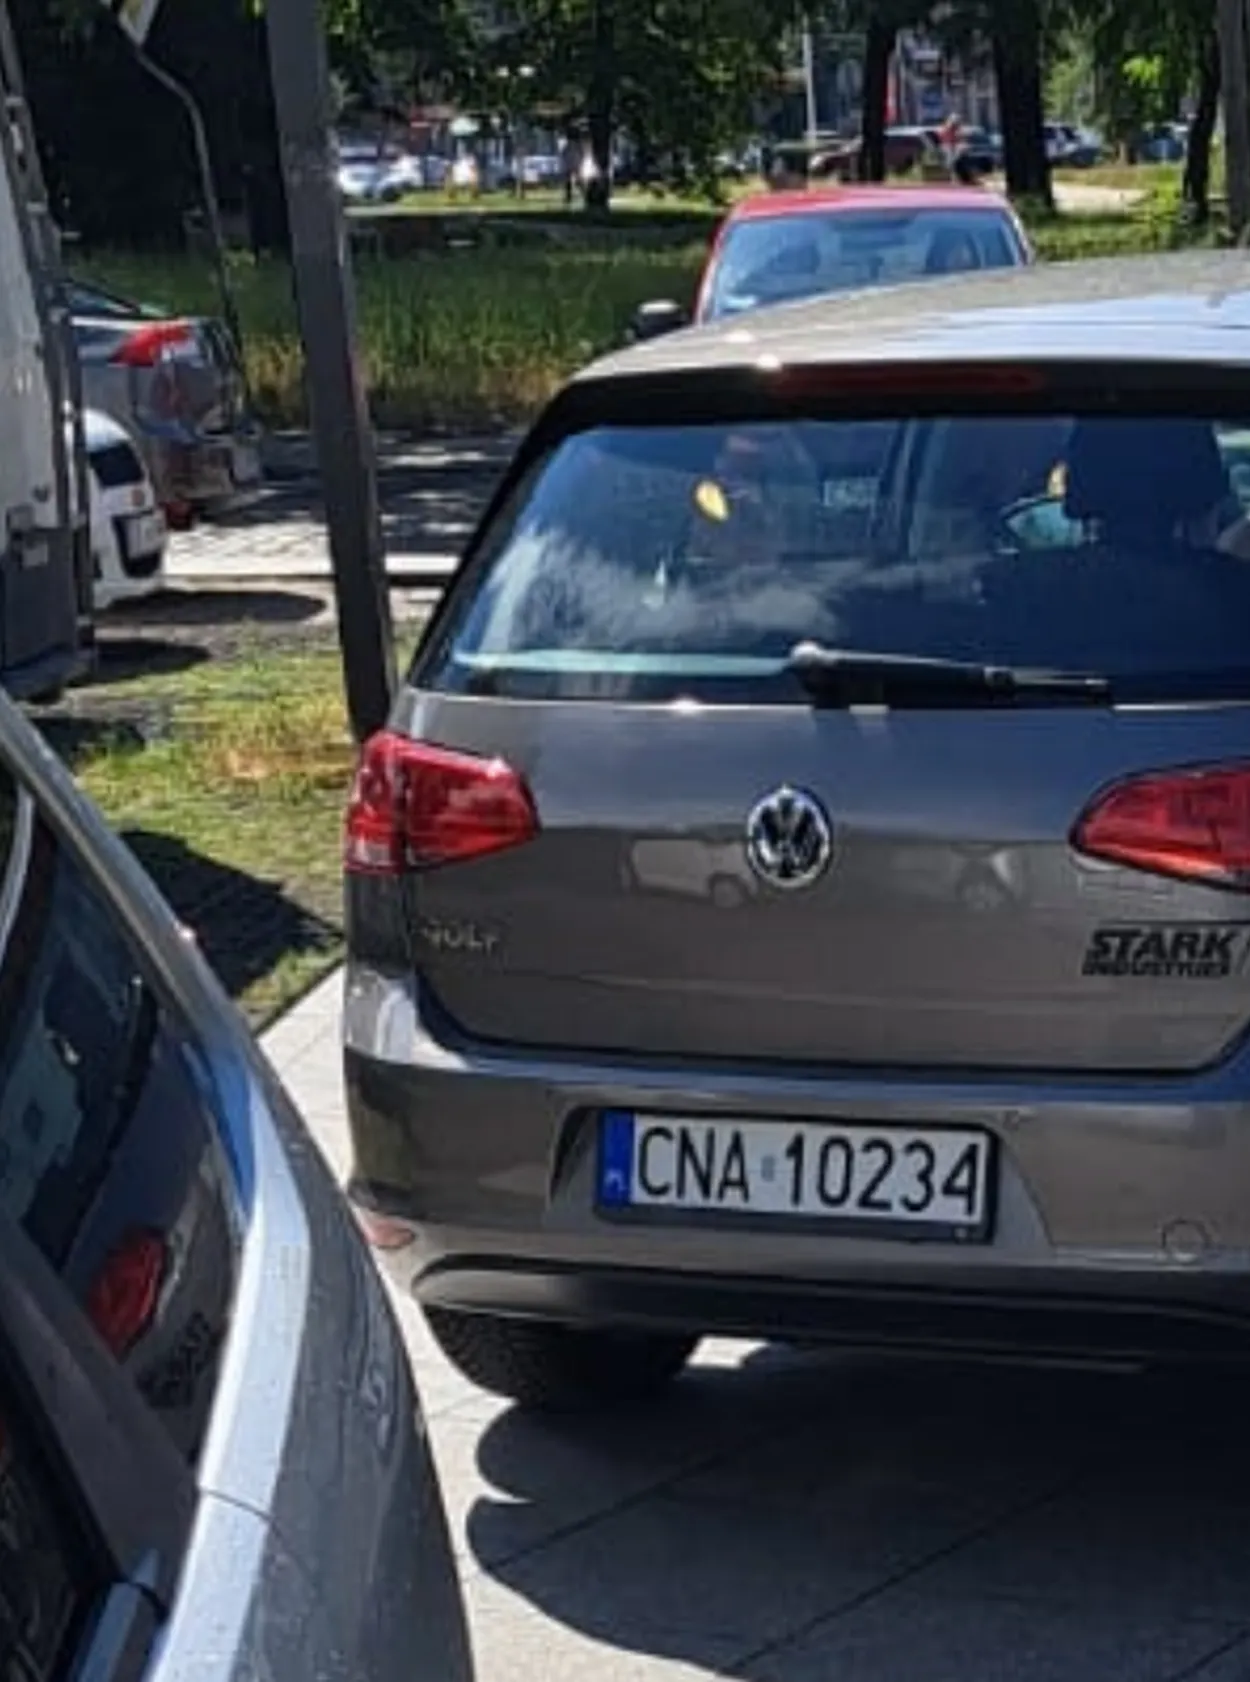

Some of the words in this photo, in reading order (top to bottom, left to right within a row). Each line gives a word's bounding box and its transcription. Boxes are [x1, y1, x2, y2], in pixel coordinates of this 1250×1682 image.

[1086, 928, 1239, 961] STARK
[637, 1125, 750, 1203] CNA
[784, 1131, 980, 1218] 10234
